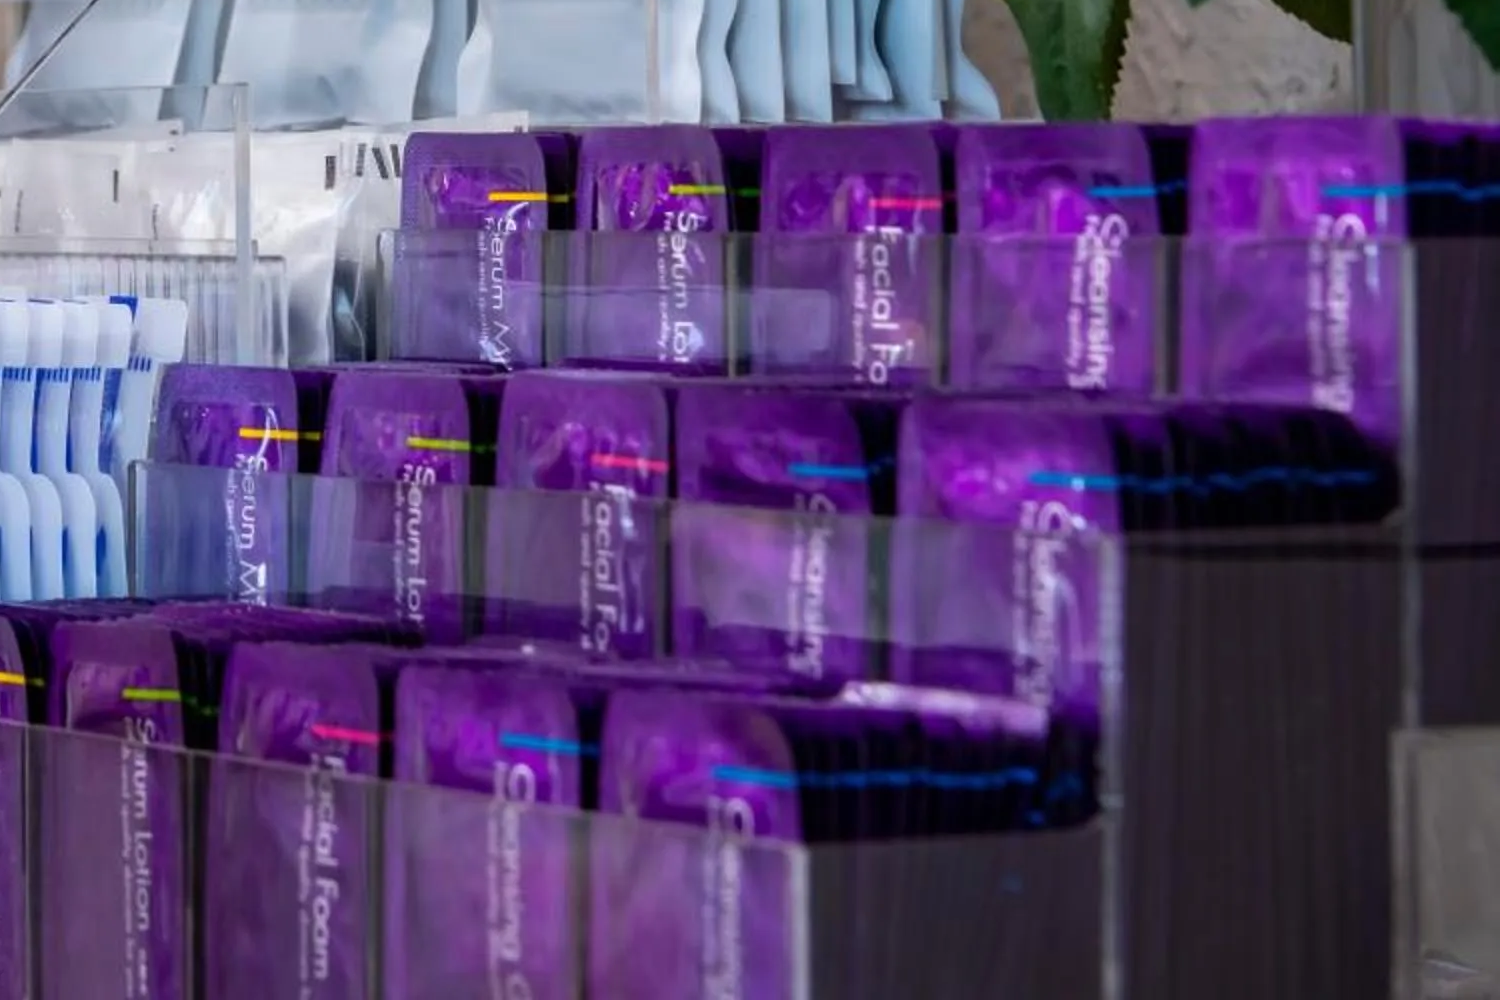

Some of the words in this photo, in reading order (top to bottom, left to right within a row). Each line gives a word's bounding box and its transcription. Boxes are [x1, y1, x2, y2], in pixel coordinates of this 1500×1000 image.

[491, 215, 517, 310] Serum
[670, 211, 700, 309] Serum
[870, 225, 903, 330] Facial
[868, 344, 900, 385] Fo
[238, 455, 268, 549] Serum
[407, 464, 436, 565] Serum
[594, 484, 625, 591] Facial
[594, 604, 619, 652] Fo
[132, 718, 156, 819] Serum
[314, 755, 345, 867] Facial
[133, 831, 154, 931] Lotion
[312, 877, 340, 980] Foam
